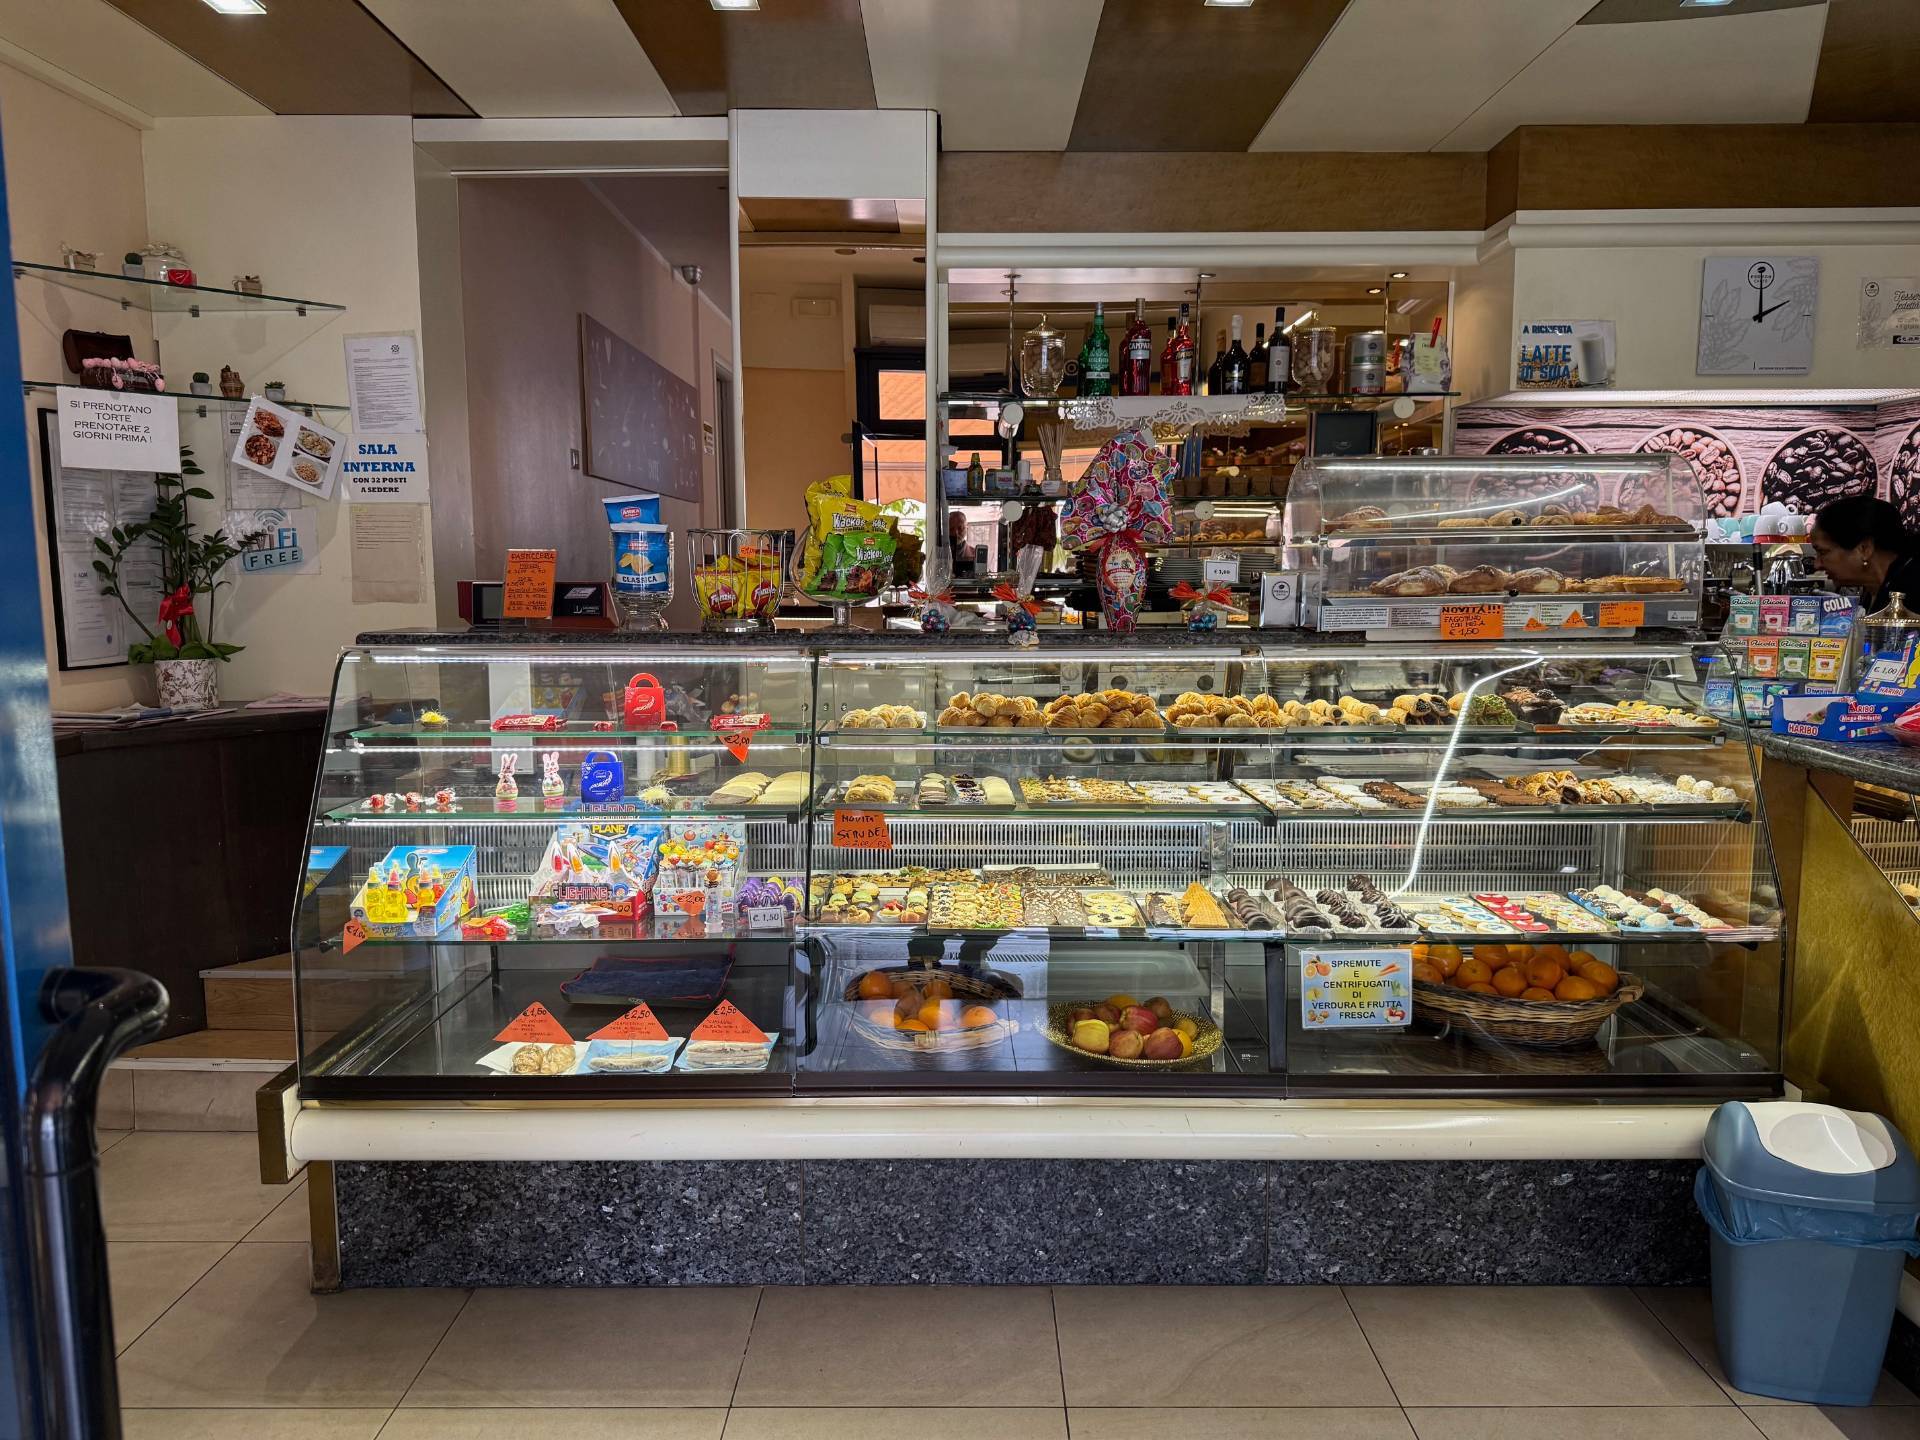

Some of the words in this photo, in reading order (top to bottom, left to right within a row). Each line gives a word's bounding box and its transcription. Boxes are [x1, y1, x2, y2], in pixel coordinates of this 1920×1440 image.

[1523, 325, 1529, 334] A
[1521, 345, 1572, 363] LATTE
[70, 400, 80, 409] SI
[83, 401, 152, 414] PRENOTANO
[95, 412, 132, 423] TORTE
[74, 420, 142, 433] PRENOTARE
[143, 426, 150, 434] 2
[72, 430, 112, 441] GIORNI
[114, 433, 147, 443] PRIMA
[358, 444, 398, 455] SALA
[343, 461, 416, 473] INTERNA
[250, 550, 299, 568] FREE
[1732, 598, 1758, 606] Ricola
[1762, 598, 1788, 606] Ricola
[1792, 598, 1820, 607] Ricola
[1823, 597, 1852, 612] GOLIA
[1750, 639, 1776, 647] Ricola
[1780, 640, 1808, 648] Ricola
[1813, 640, 1841, 650] Ricola
[1878, 687, 1905, 696] HARIBO
[1788, 723, 1818, 735] HARIBO
[592, 825, 626, 834] PLANE
[1331, 960, 1382, 968] SPREMUTE
[1323, 980, 1391, 989] CENTRIFUGATI
[1352, 991, 1362, 999] DI
[1312, 1001, 1357, 1010] VERDURA
[1367, 1001, 1402, 1009] FRUTTA
[1339, 1011, 1376, 1019] FRESCA
